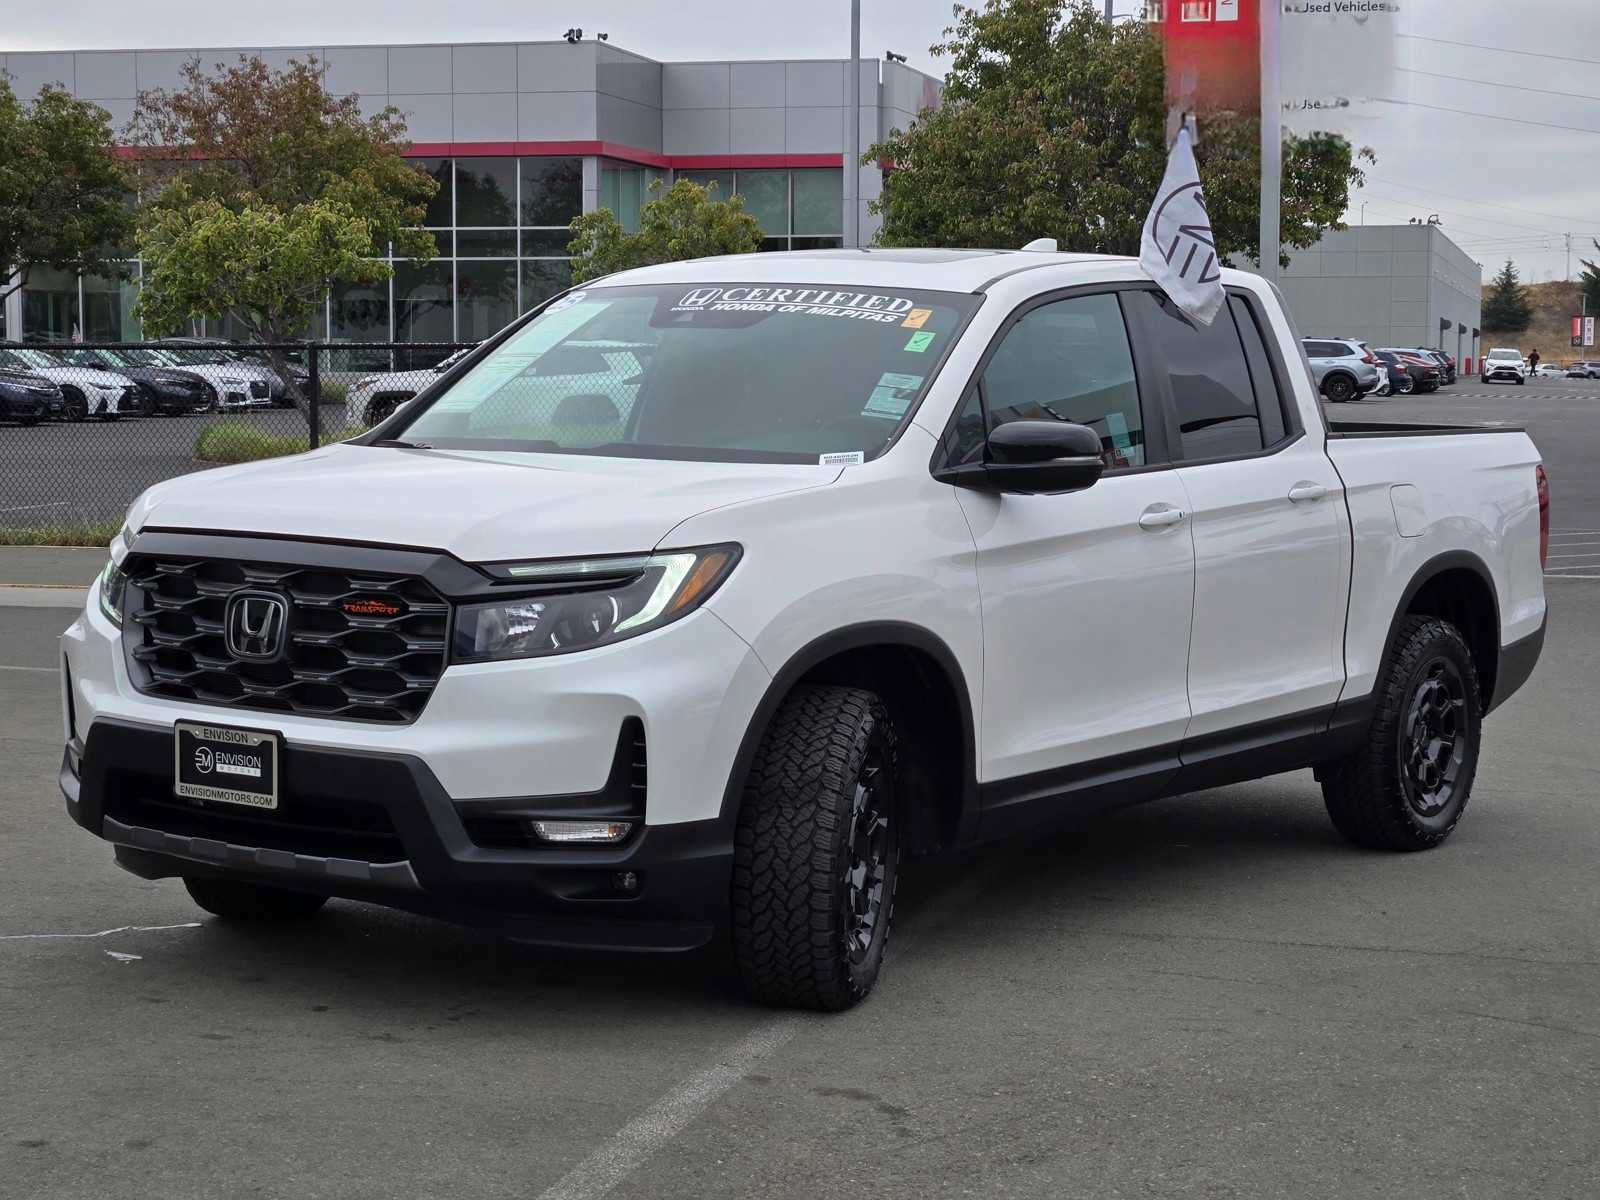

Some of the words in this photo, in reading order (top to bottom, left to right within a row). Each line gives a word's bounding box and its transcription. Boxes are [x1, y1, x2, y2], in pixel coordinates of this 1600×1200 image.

[1334, 0, 1385, 12] Vehicles
[722, 287, 913, 312] CERTIFIED
[709, 303, 776, 312] HONDA
[778, 305, 809, 313] OF
[805, 306, 898, 323] MILPITAS
[203, 728, 249, 743] ENVISION
[216, 752, 262, 768] ENVISION
[180, 785, 273, 806] ENVISIONMOTORS.COM
